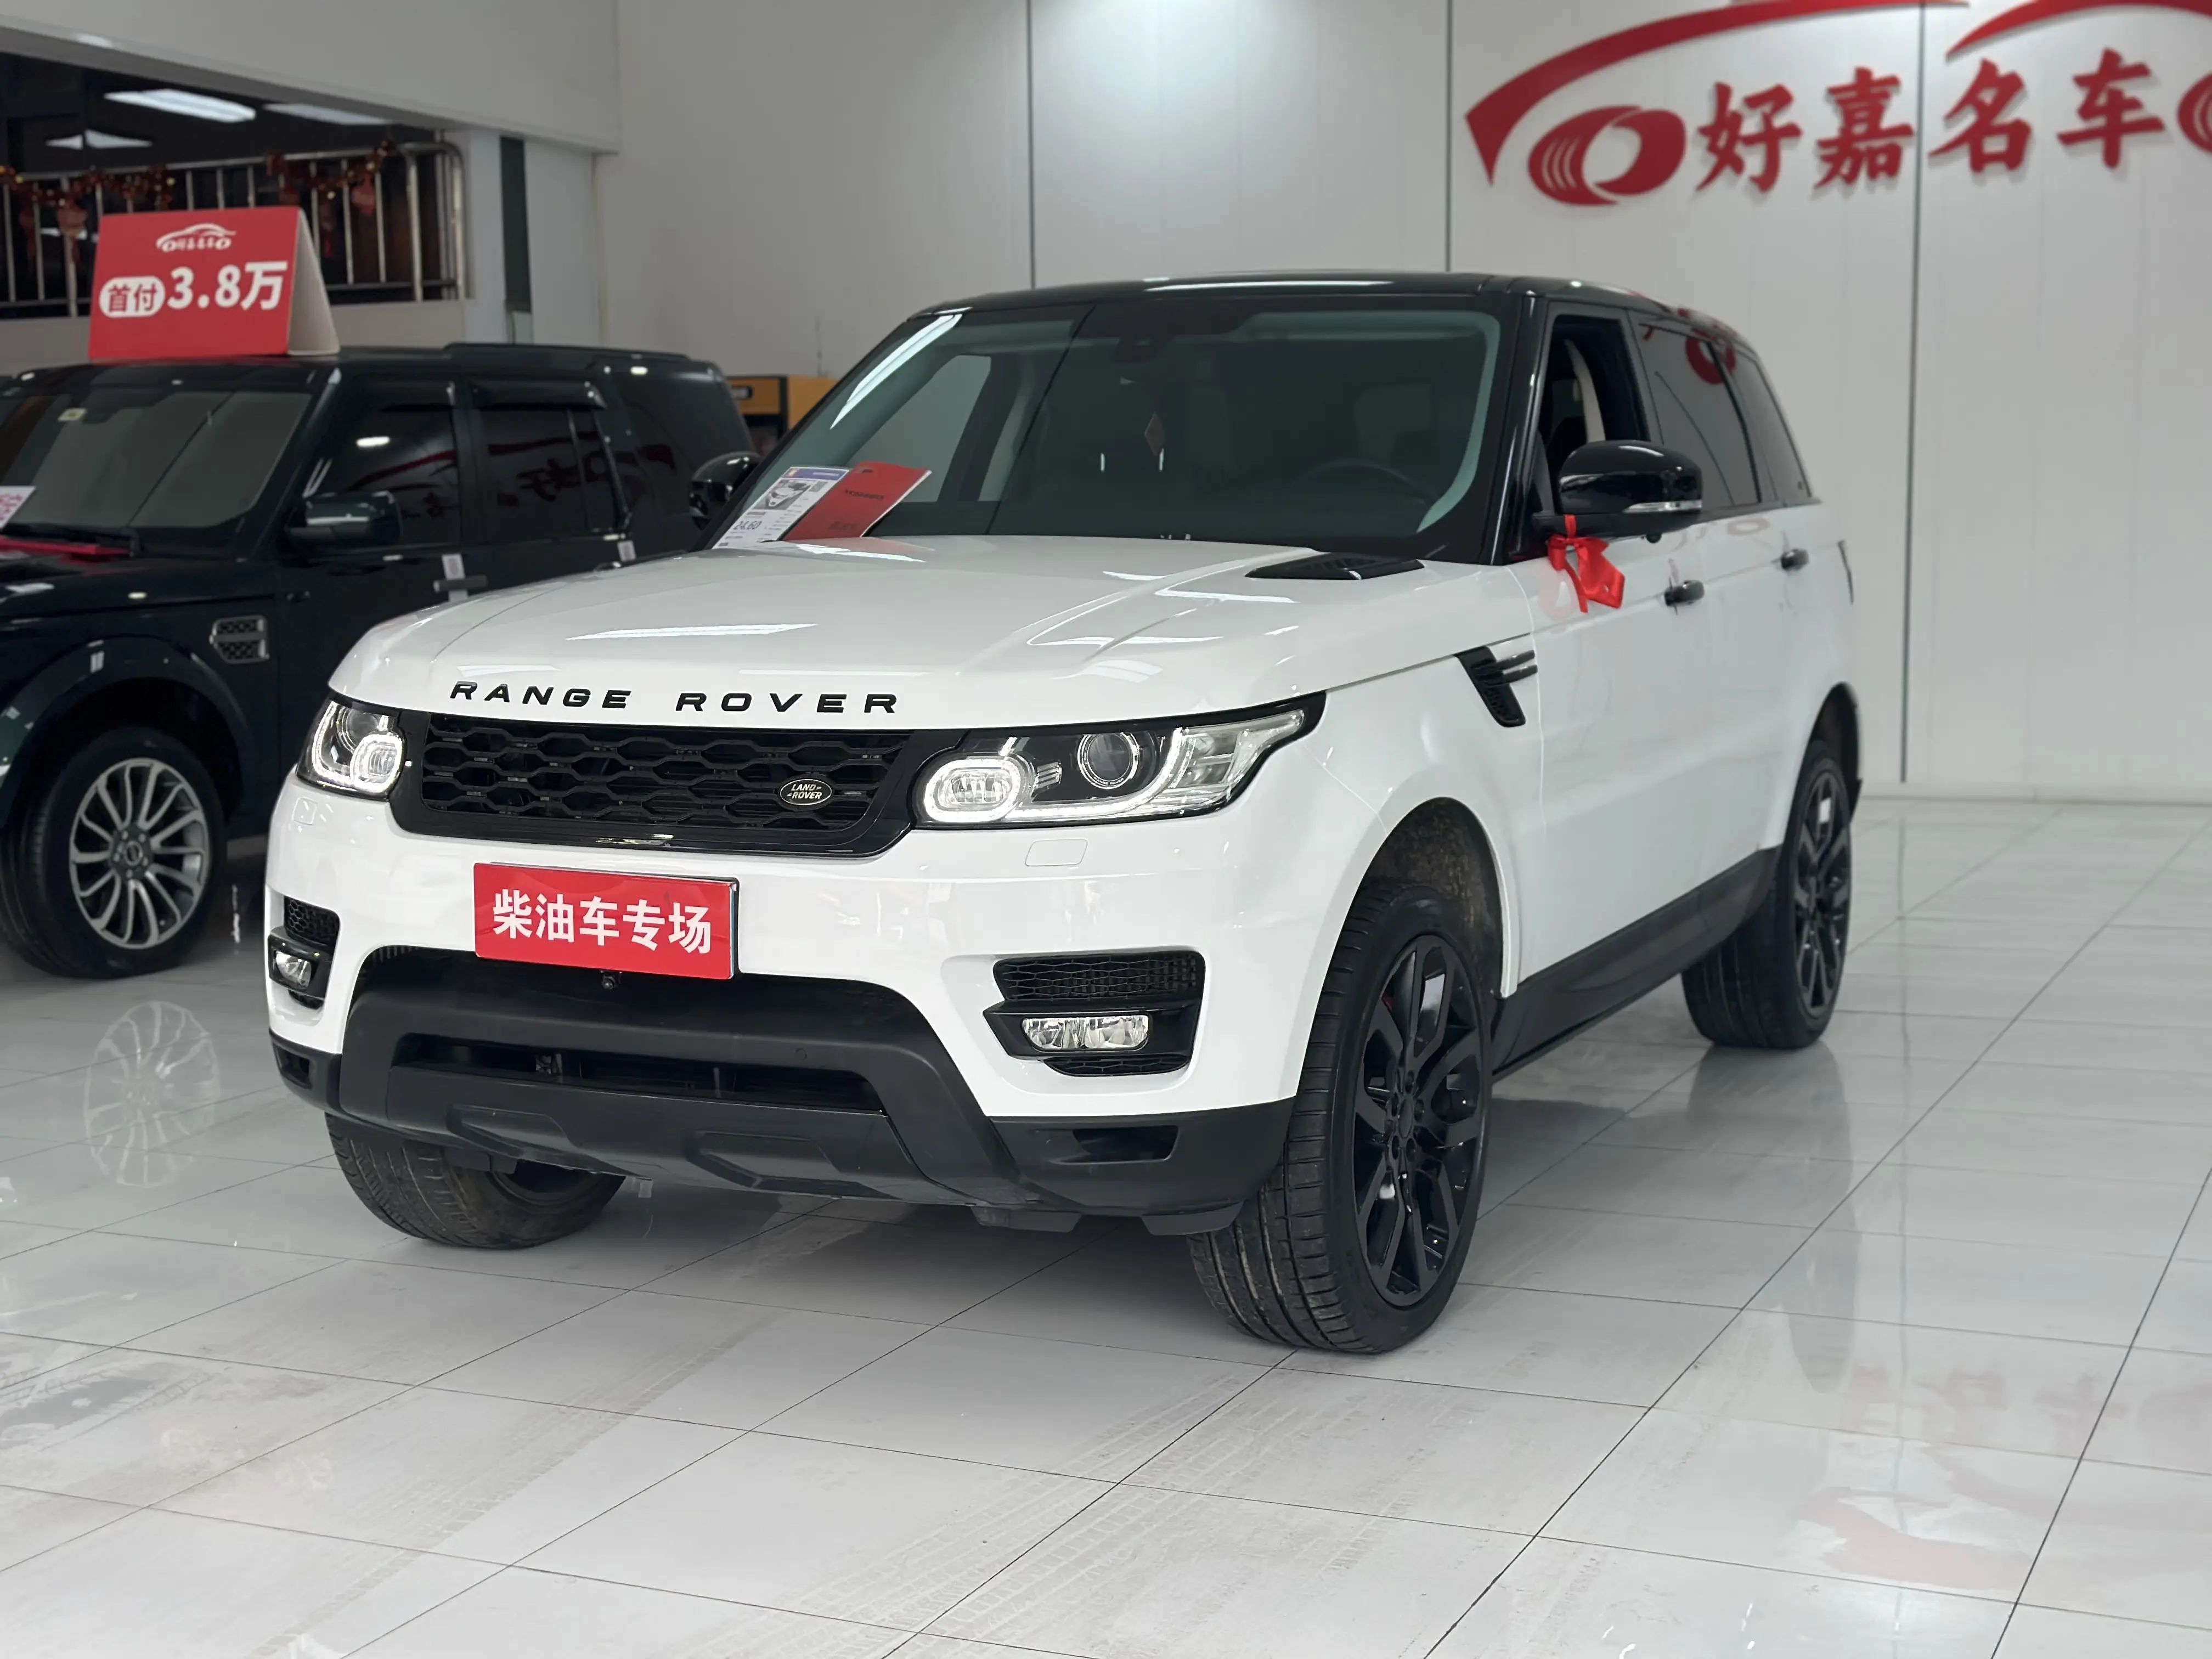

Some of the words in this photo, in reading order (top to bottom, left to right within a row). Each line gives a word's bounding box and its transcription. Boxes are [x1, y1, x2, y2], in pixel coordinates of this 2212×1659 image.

[1694, 47, 2165, 193] 好嘉名车
[108, 283, 157, 312] 首付
[167, 261, 288, 311] 3.8万
[450, 681, 631, 709] RANGE
[675, 692, 897, 713] ROVER
[493, 889, 711, 953] 柴油车专场
